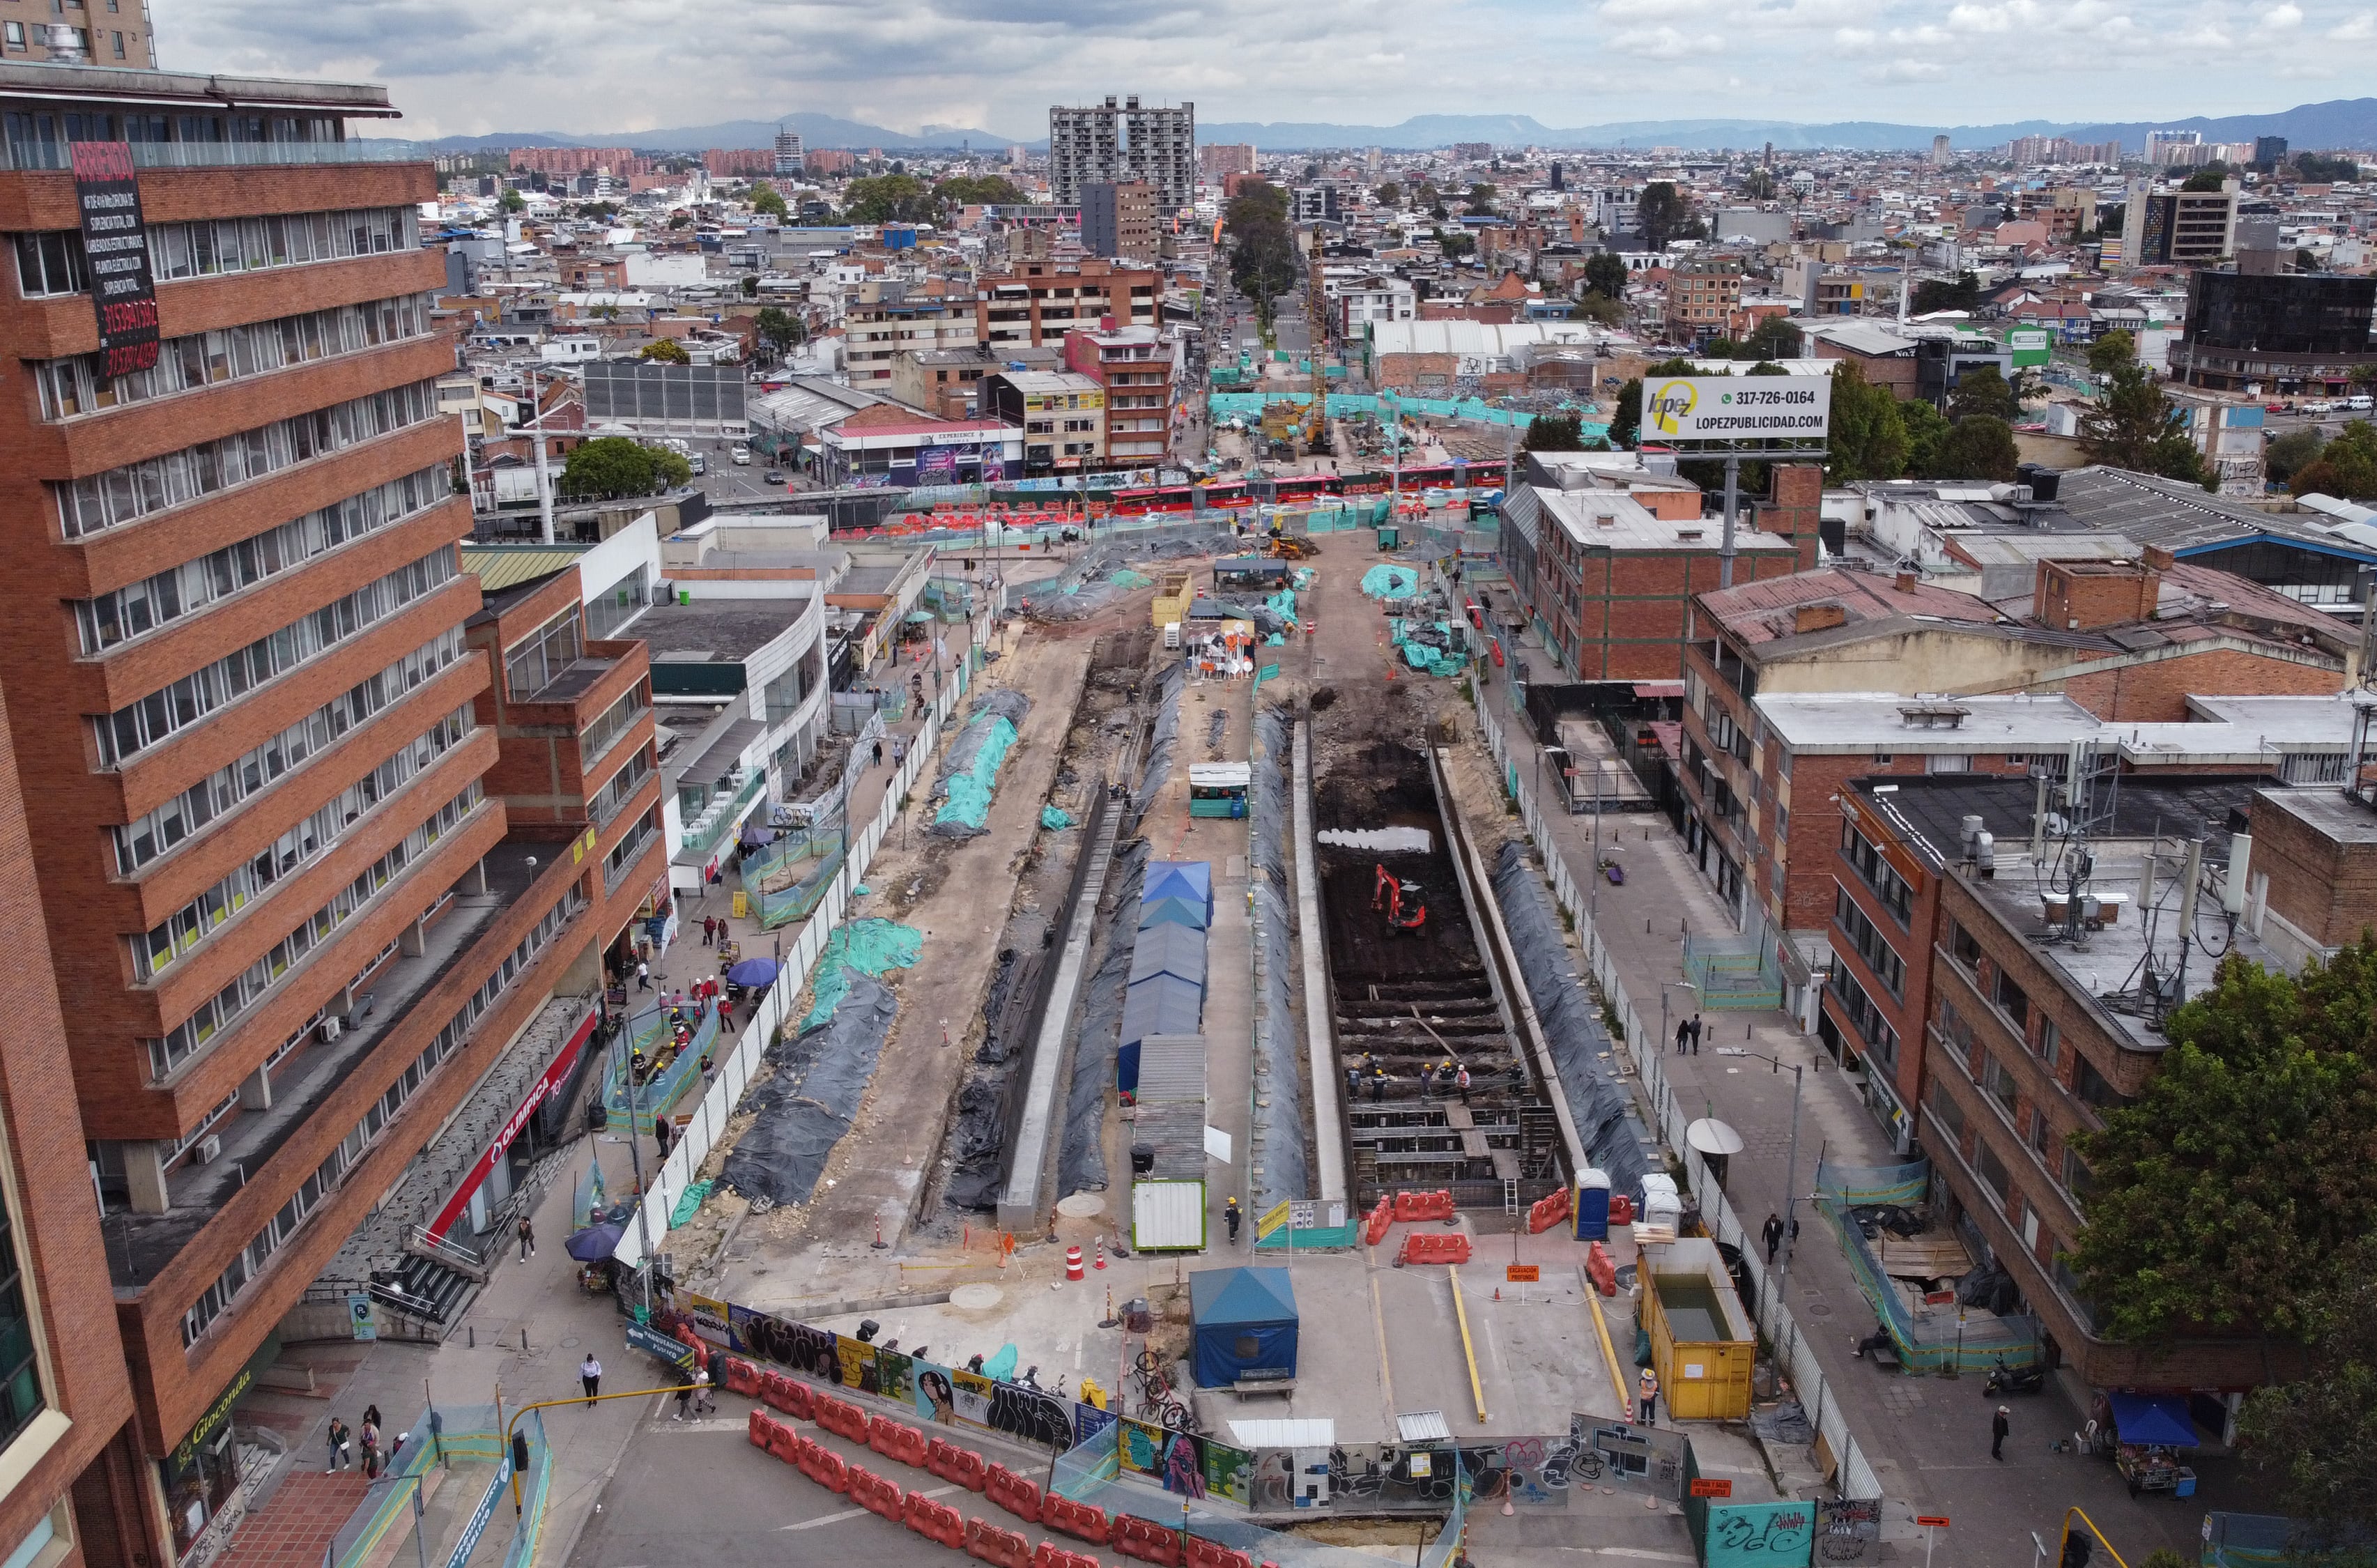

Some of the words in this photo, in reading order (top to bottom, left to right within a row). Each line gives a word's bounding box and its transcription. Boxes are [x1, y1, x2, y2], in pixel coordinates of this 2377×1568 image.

[70, 141, 134, 183] ARRIENDO
[1736, 391, 1815, 405] 317-726-0164
[1696, 416, 1823, 429] LOPEZPUBLICIDAD.COM
[1869, 1070, 1879, 1093] Cruz
[1878, 1083, 1891, 1111] Verde
[502, 1077, 549, 1146] OLIMPICA
[644, 1330, 686, 1354] PARQUEADERO
[193, 1370, 251, 1445] Gioconda
